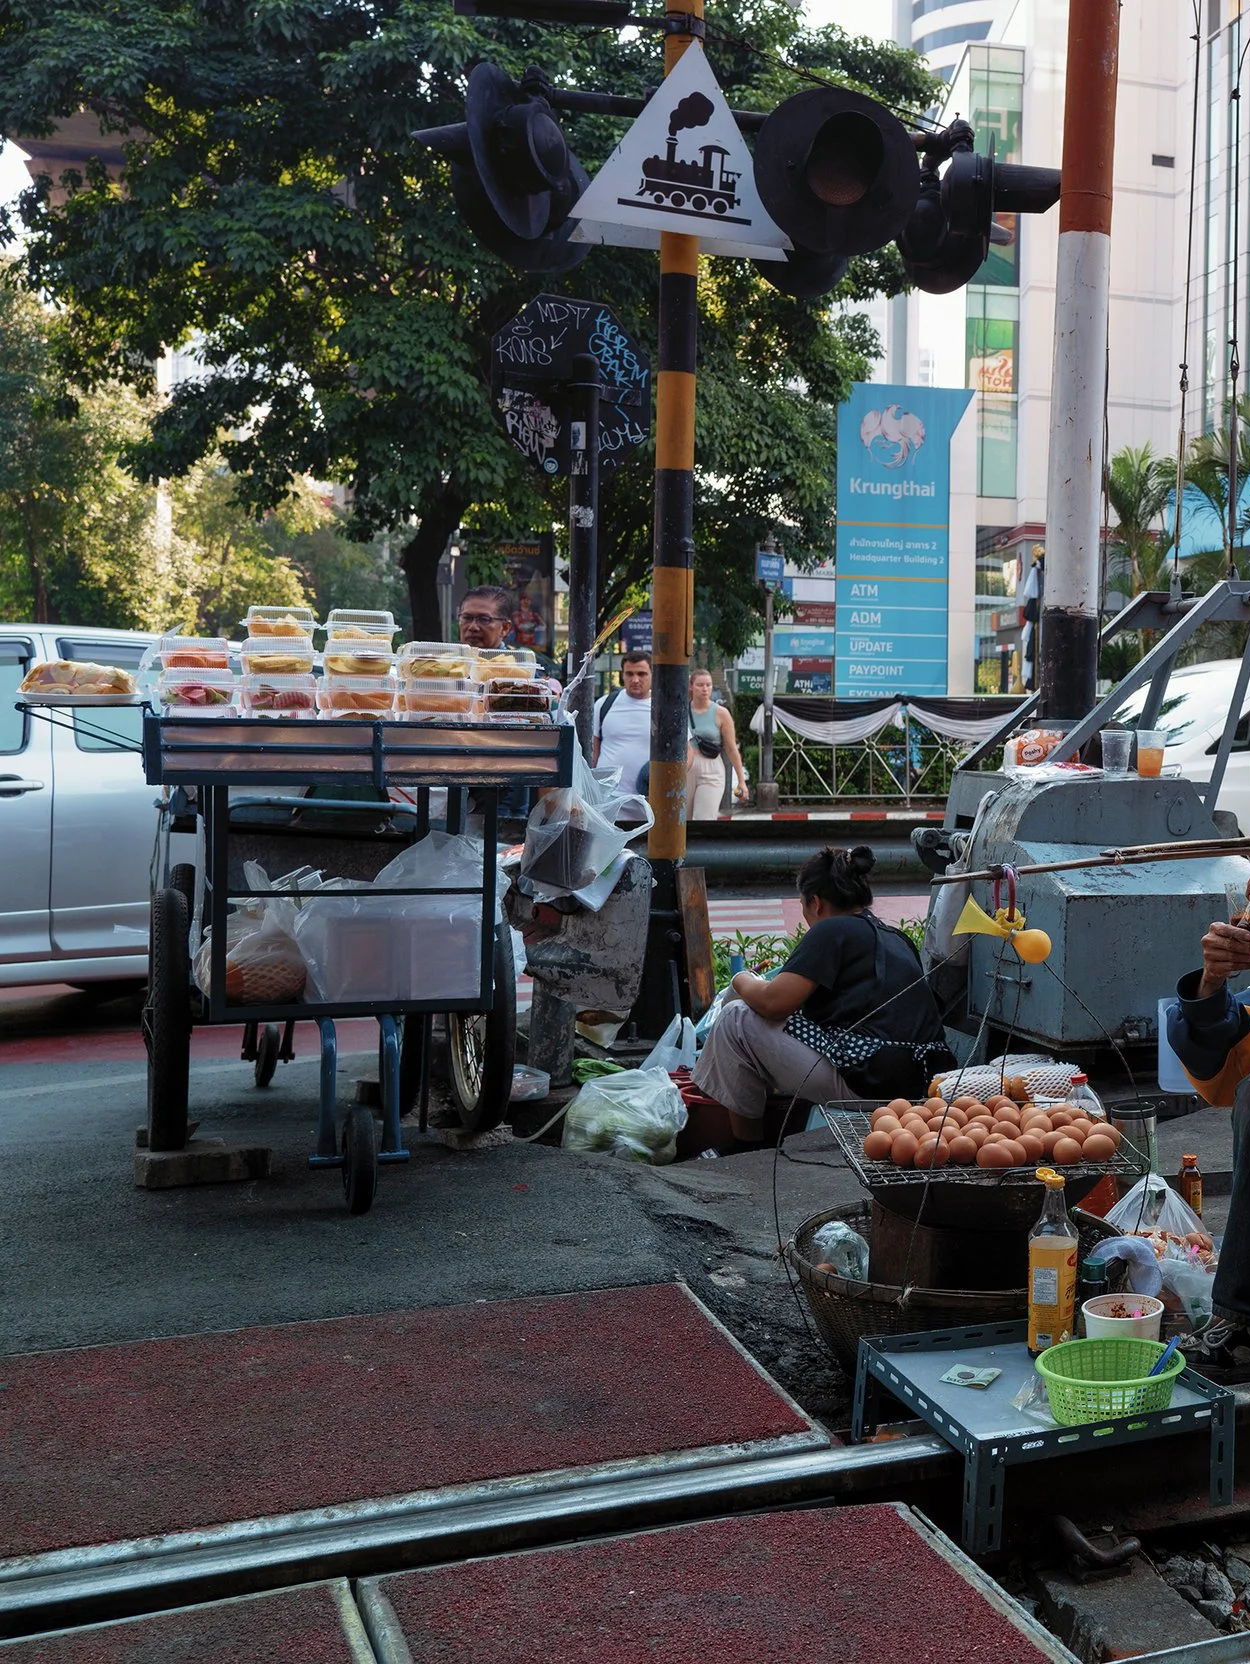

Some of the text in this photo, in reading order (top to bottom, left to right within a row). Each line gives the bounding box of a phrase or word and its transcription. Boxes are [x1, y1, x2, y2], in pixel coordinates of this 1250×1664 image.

[849, 477, 936, 500] Krungthai
[931, 541, 937, 550] 2
[849, 553, 945, 565] Headquarter Building 2
[850, 584, 879, 597] ATM
[850, 611, 882, 624] ADM
[849, 641, 893, 653] UPDATE
[848, 664, 905, 676] PAYPOINT
